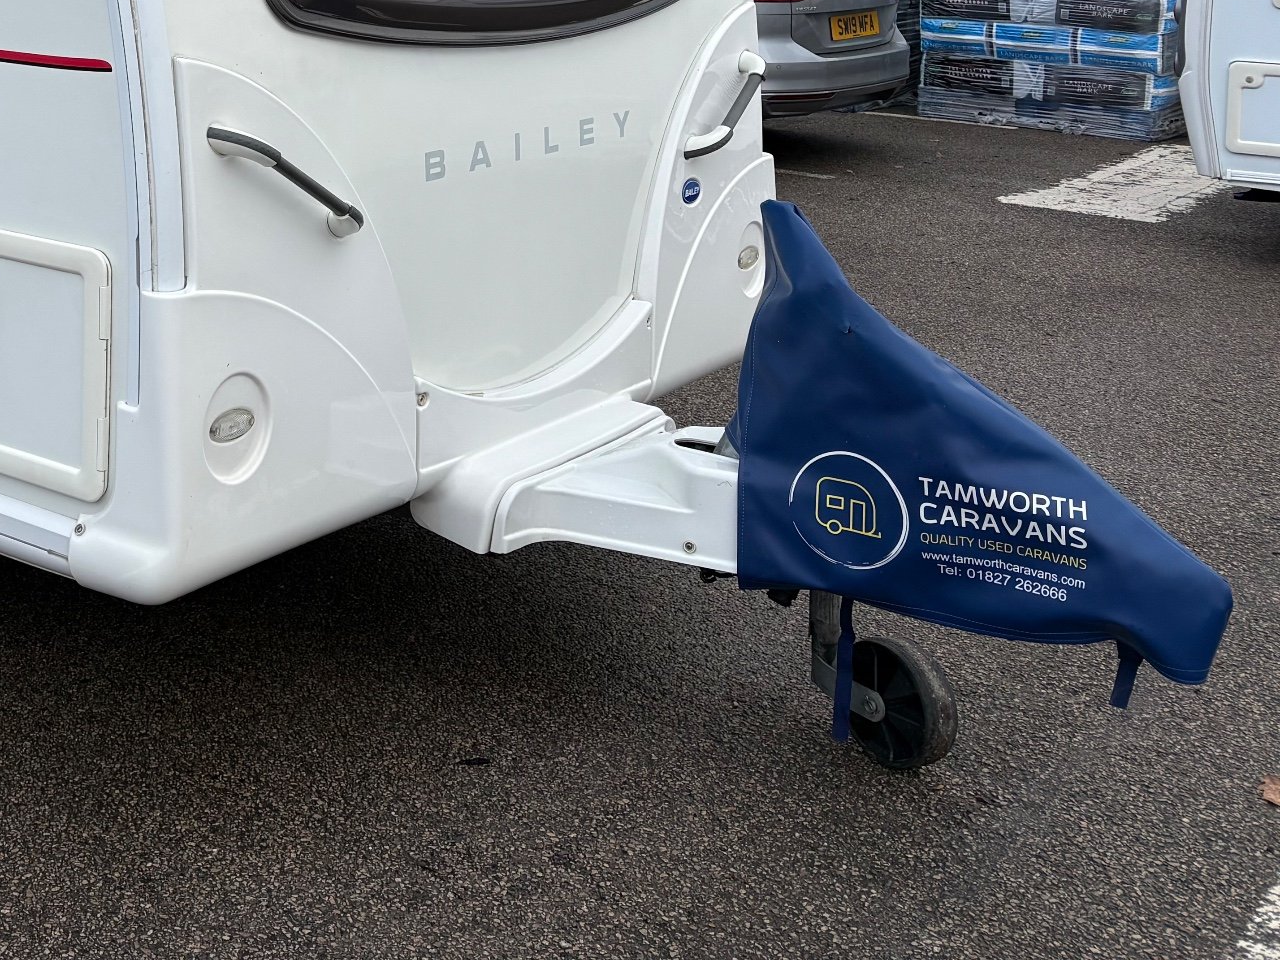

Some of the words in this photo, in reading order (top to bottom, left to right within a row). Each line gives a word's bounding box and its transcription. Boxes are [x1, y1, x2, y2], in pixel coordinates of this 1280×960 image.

[1079, 4, 1128, 16] LANDSCAPE
[424, 110, 631, 182] BAILEY
[918, 476, 1088, 521] TAMWORTH
[919, 502, 1088, 550] CARAVANS
[920, 532, 974, 548] QUALITY
[978, 538, 1013, 554] USED
[1016, 545, 1087, 570] CARAVANS
[921, 551, 1086, 590] www.tamworthcaravans.com
[937, 563, 962, 577] Tel:
[966, 568, 1012, 586] 01827
[1014, 577, 1067, 602] 262666
